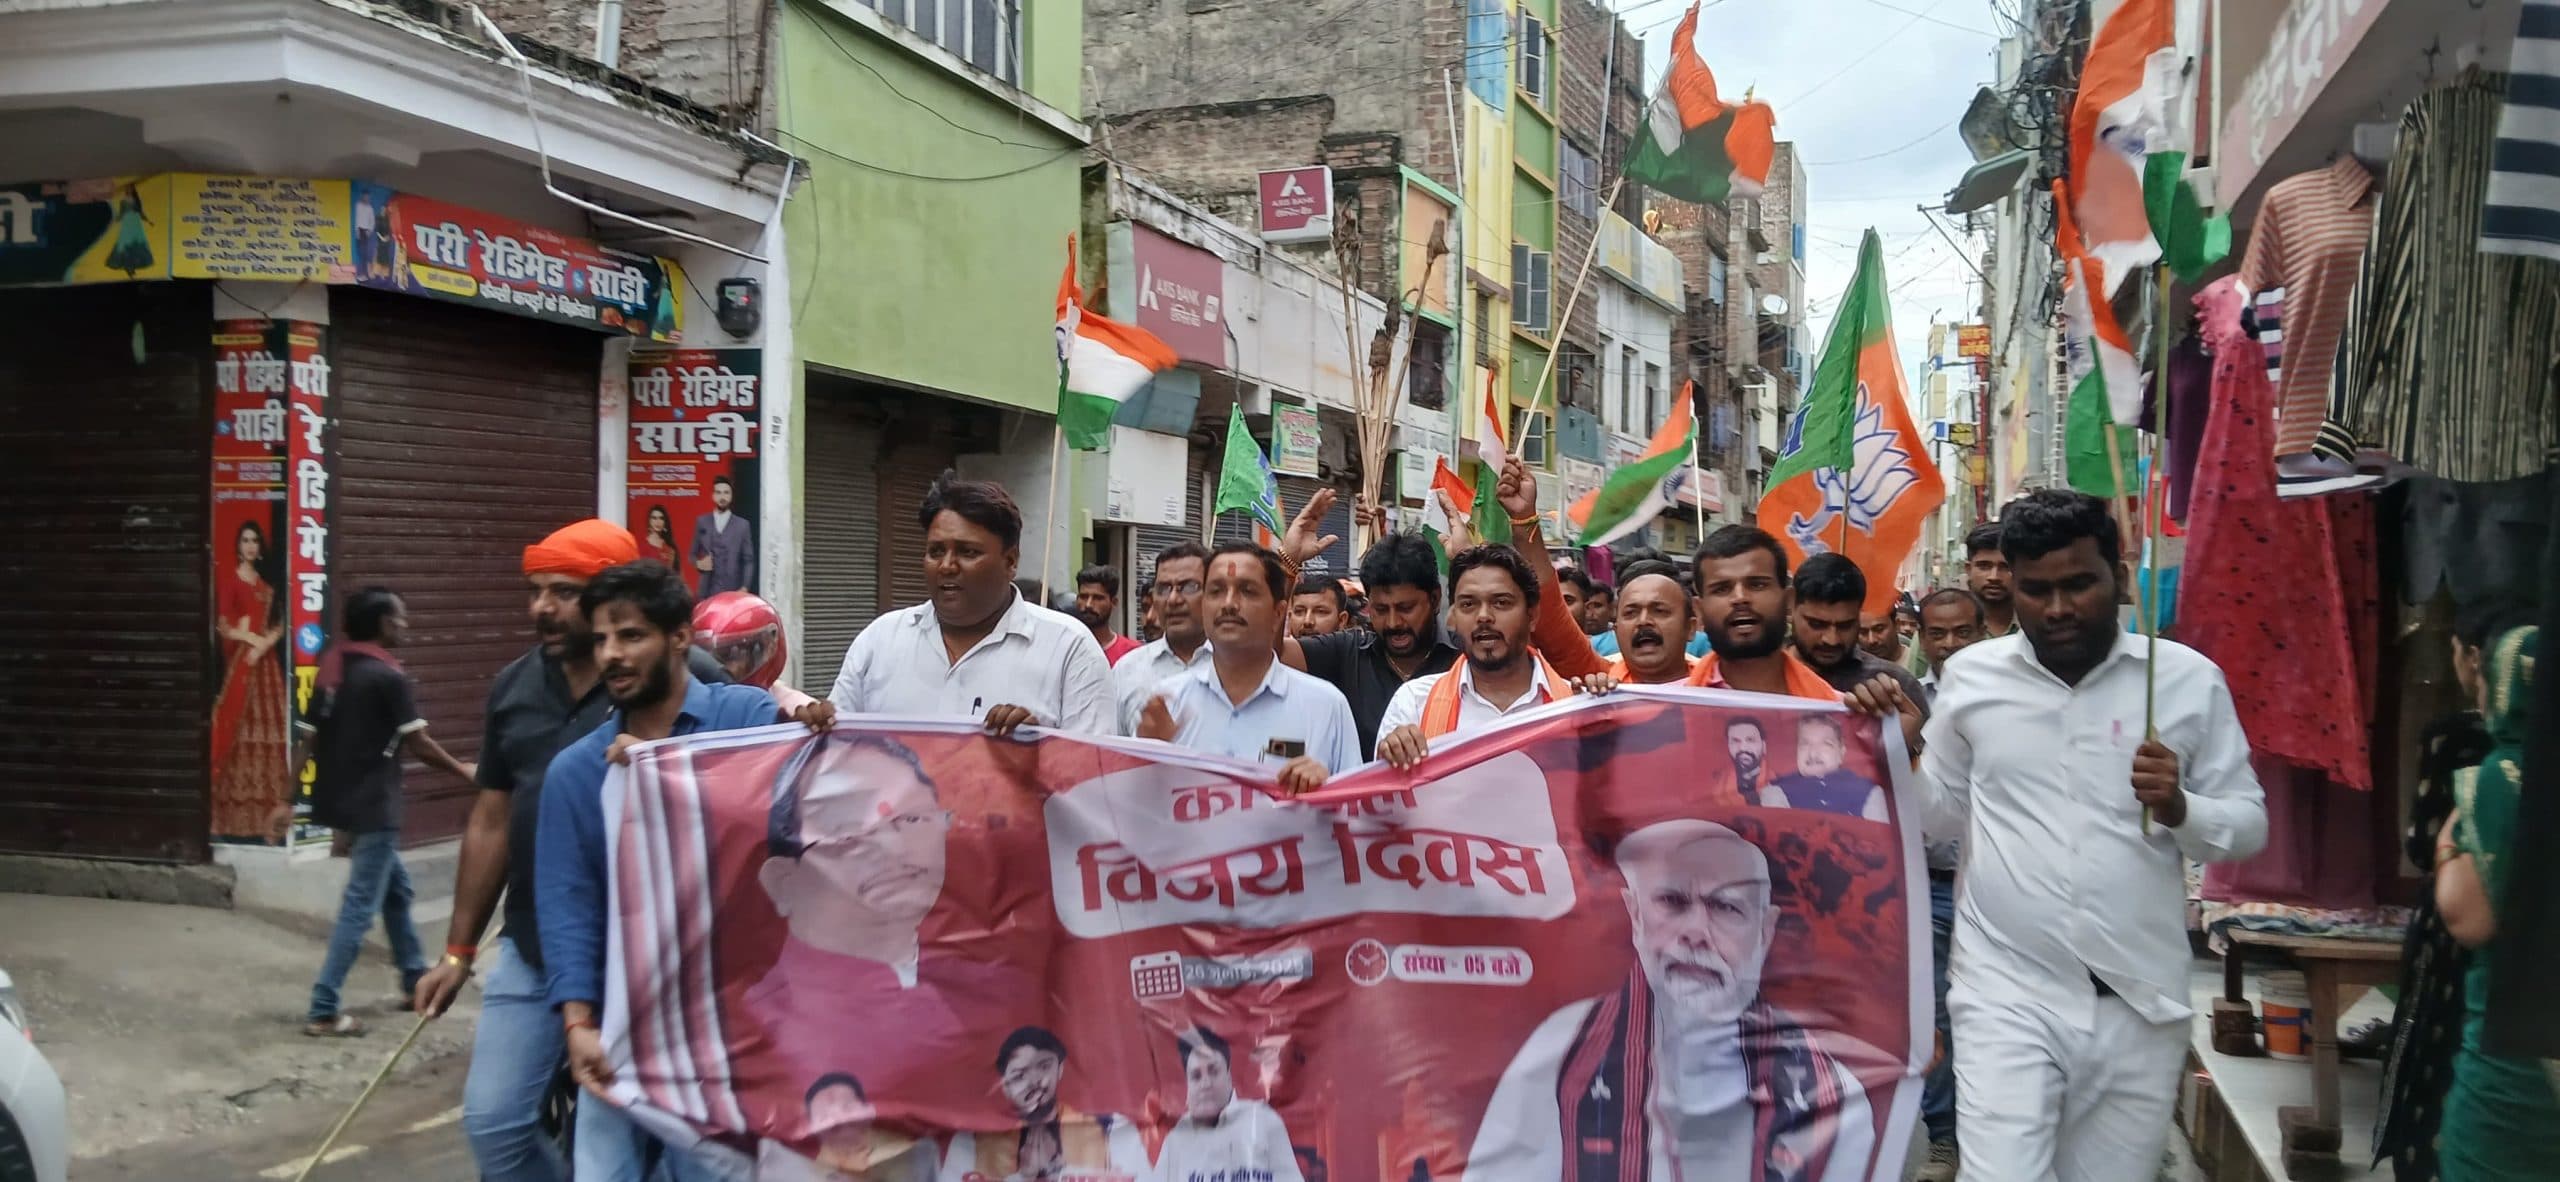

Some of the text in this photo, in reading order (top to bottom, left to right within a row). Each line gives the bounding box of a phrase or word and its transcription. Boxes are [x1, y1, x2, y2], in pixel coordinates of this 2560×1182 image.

[413, 222, 470, 268] परी
[473, 228, 569, 289] रेडिमेड
[587, 265, 649, 312] साड़ी
[1155, 279, 1201, 307] AXIS BANK
[215, 351, 240, 393] परी
[291, 355, 331, 397] परी
[632, 366, 757, 407] परी रेडिमेड
[232, 399, 287, 450] साड़ी
[631, 412, 757, 462] साड़ी
[1075, 823, 1547, 912] विजय दिवस
[1464, 954, 1485, 975] 05
[1489, 951, 1521, 976] बजे
